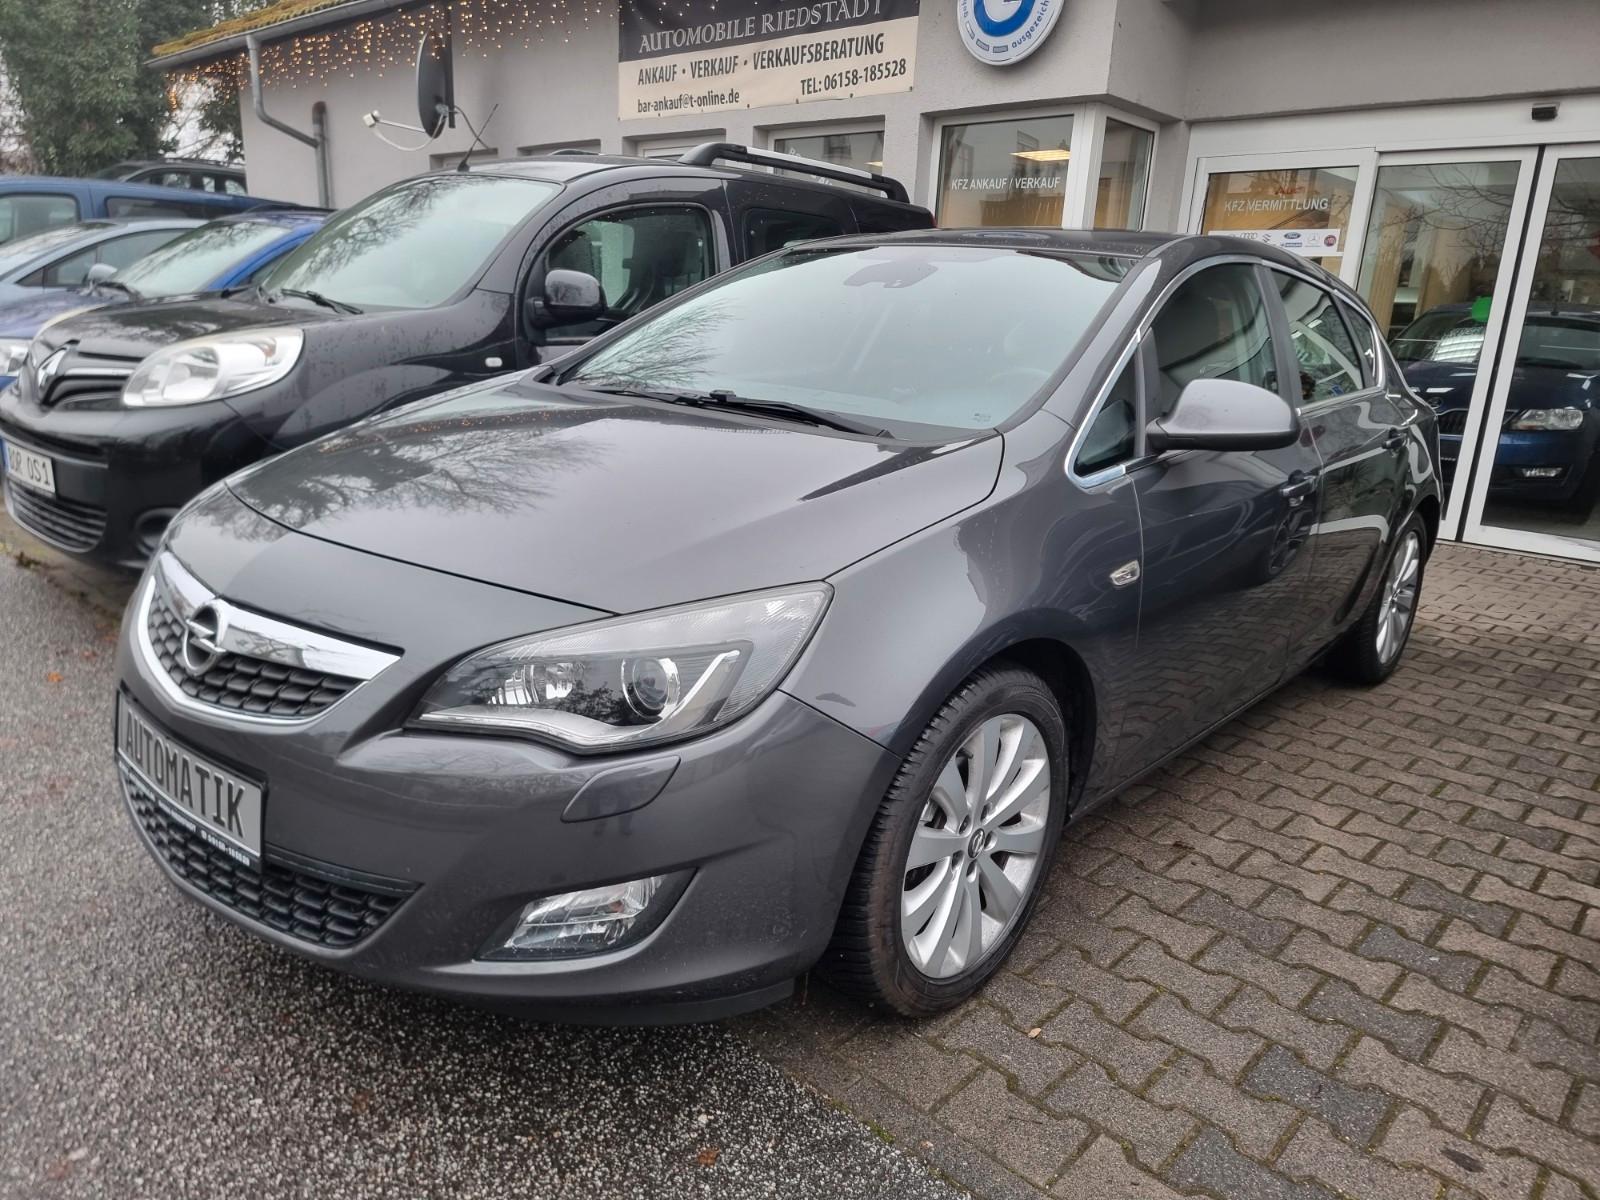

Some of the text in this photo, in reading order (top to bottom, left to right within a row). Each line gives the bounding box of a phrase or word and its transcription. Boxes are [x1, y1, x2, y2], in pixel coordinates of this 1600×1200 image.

[638, 0, 882, 53] AUTOMOBILE RIEDSTADT
[638, 33, 884, 85] ANKAUF VERKAUF VERKAUFSBERATUNG
[800, 58, 907, 95] TEL: 06158-185528
[637, 88, 740, 113] bar-ankauf@t-online.de
[951, 178, 969, 190] KFZ
[970, 177, 1008, 190] ANKAUF
[1014, 176, 1061, 189] VERKAUF
[1224, 198, 1329, 212] KFZ VERMITTLUNG
[125, 708, 246, 838] AUTOMATIK
